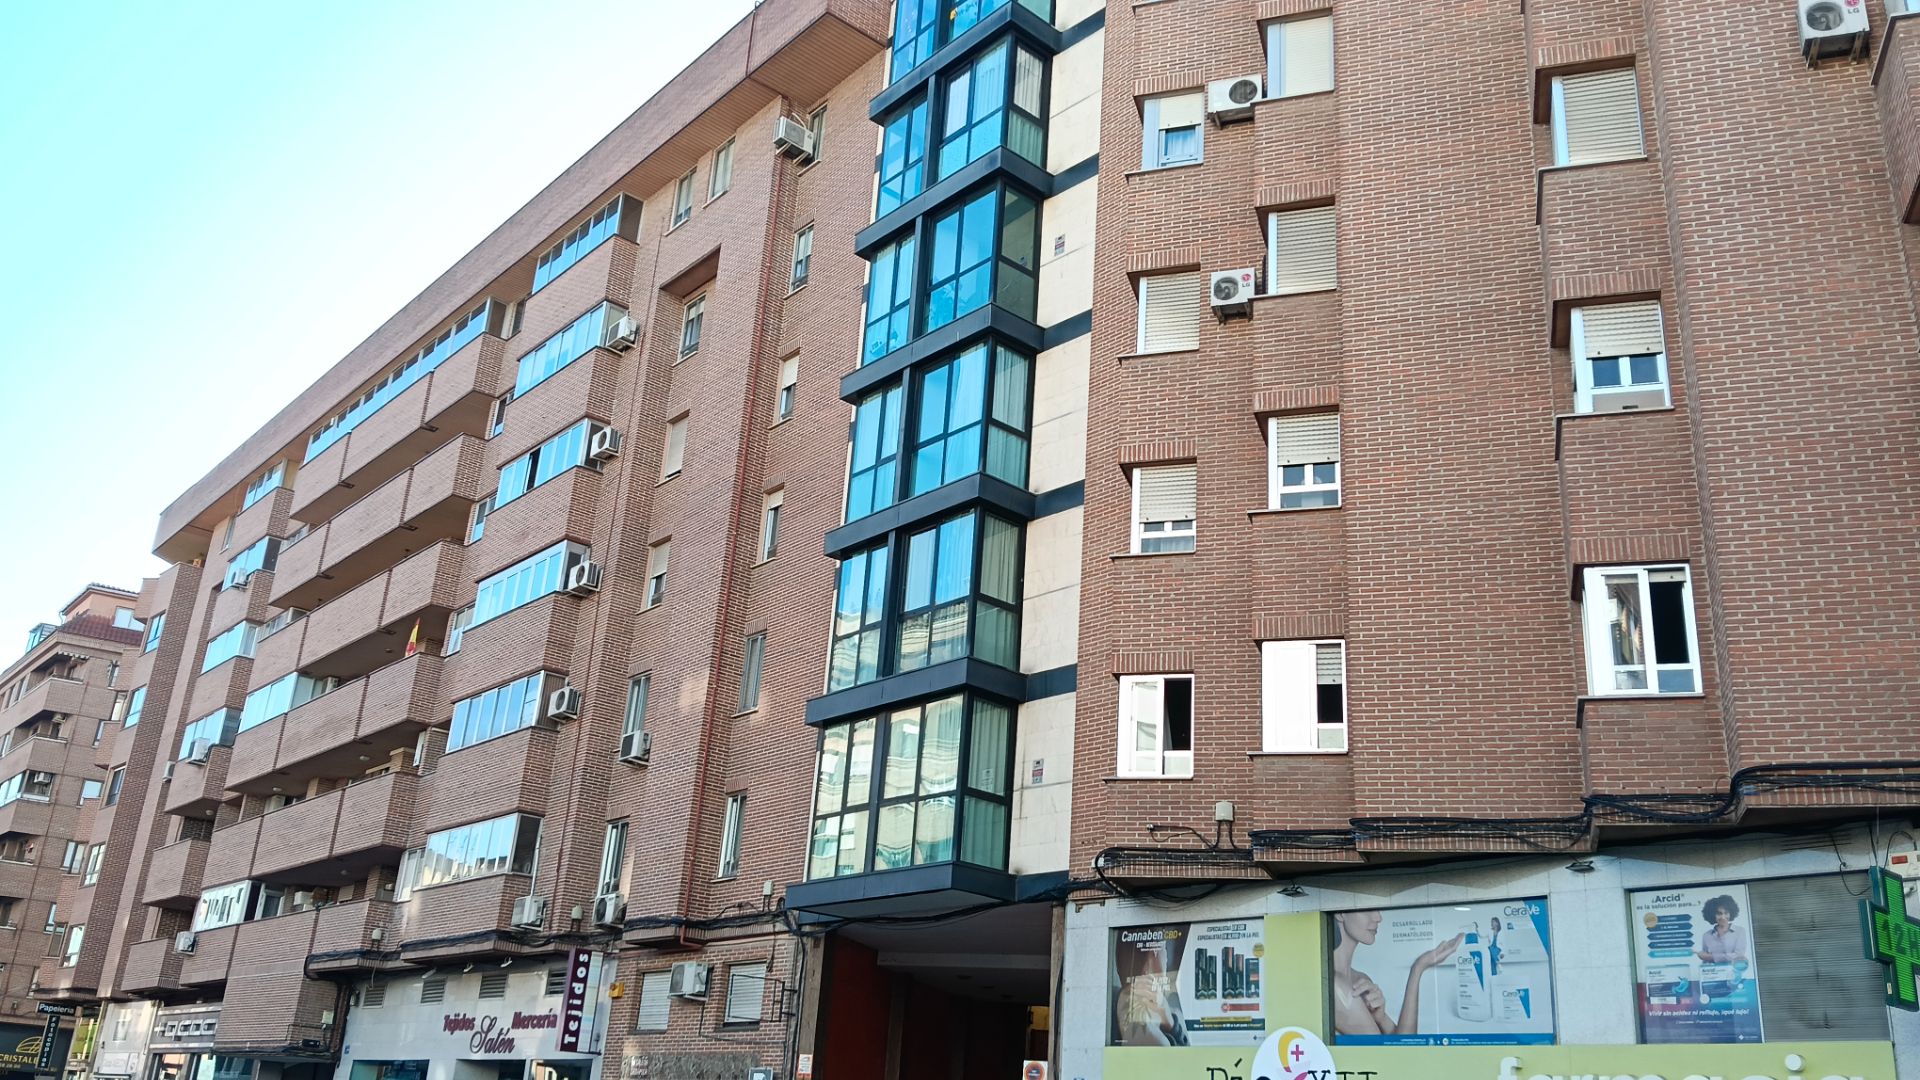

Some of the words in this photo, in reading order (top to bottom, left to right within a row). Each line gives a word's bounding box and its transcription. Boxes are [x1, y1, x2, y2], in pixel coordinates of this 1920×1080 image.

[1503, 904, 1541, 917] CeraVe
[1121, 929, 1163, 942] Cannaben
[1458, 955, 1480, 965] CeraVe
[564, 953, 589, 1044] Tejidos
[1502, 990, 1525, 998] CeraVe
[443, 1013, 476, 1035] Tejidos
[511, 1008, 558, 1030] Mercería
[40, 1016, 57, 1067] Fotocopias
[469, 1015, 515, 1054] Satén
